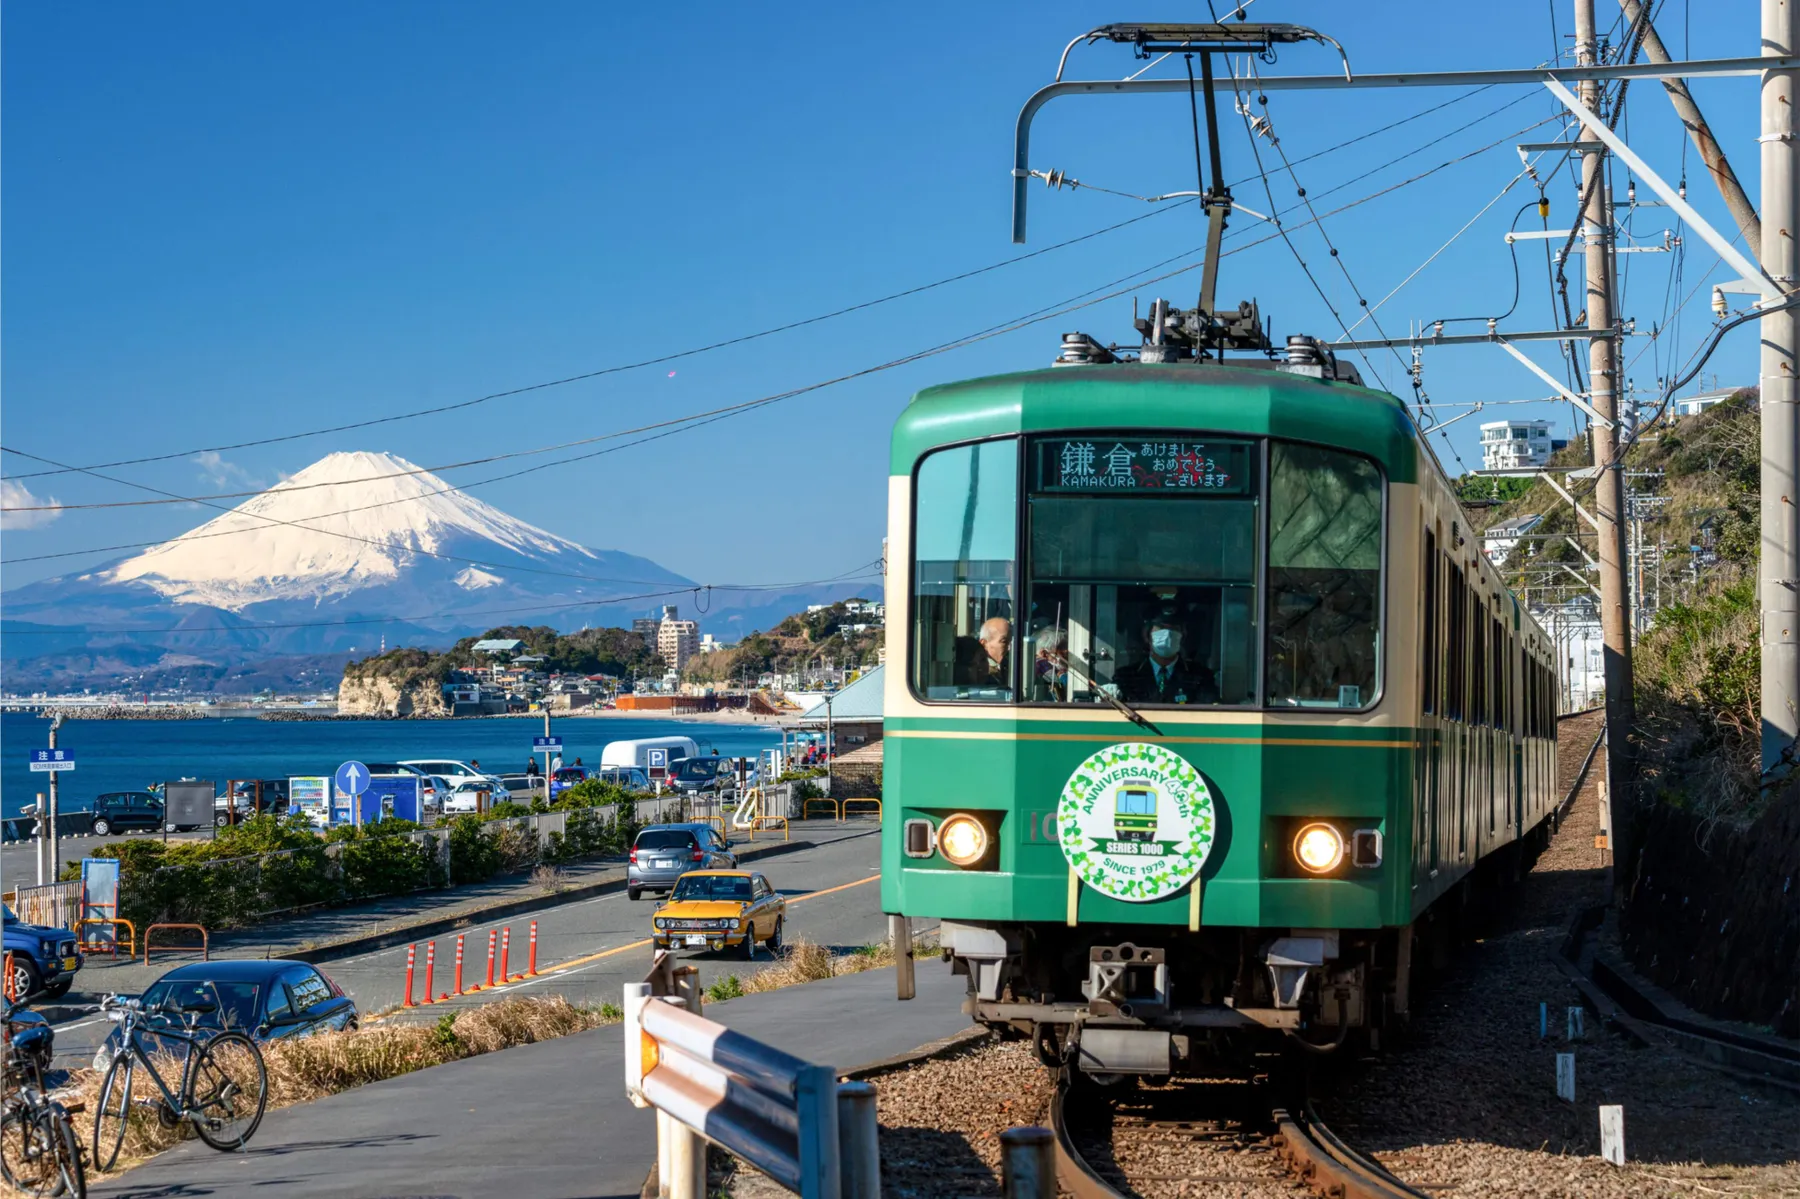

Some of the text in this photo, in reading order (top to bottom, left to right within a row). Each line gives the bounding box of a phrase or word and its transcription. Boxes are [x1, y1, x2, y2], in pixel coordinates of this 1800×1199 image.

[1141, 443, 1204, 456] あけまして
[1060, 442, 1136, 476] 鎌倉
[1153, 458, 1215, 471] おめでとう
[1061, 476, 1136, 488] KAMAKURA
[1164, 474, 1229, 487] ございます
[38, 750, 64, 761] 注意
[652, 751, 663, 766] P
[1082, 767, 1190, 818] ANNIVERSARY 40th
[1106, 841, 1164, 855] SERIES 1000
[1103, 858, 1166, 875] SINCE 1979
